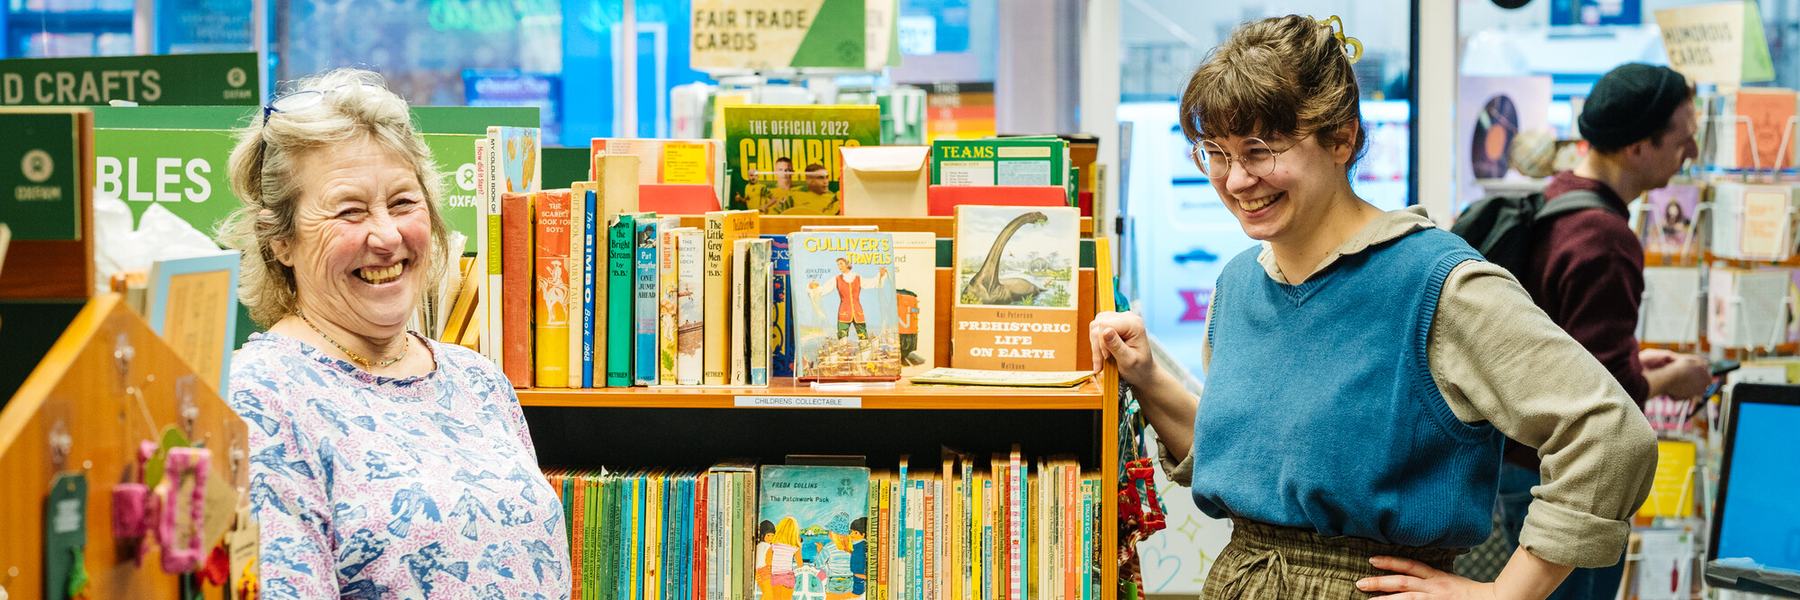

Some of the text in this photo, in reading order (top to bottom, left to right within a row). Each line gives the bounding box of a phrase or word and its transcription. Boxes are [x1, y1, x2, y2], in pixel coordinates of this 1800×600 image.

[694, 10, 809, 29] FAIR TRADE
[1665, 23, 1733, 43] HUMOROUS
[693, 33, 758, 51] CARDS
[1669, 46, 1715, 66] CARDS
[3, 70, 162, 104] D CRAFTS
[749, 120, 850, 136] THE OFFICIAL 2022
[490, 139, 496, 150] MY
[941, 146, 994, 159] TEAMS
[739, 138, 861, 182] CANARIE
[96, 155, 212, 203] BLES
[477, 178, 485, 195] Start?
[449, 195, 477, 208] OXFA
[490, 204, 497, 214] OF
[709, 220, 721, 229] The
[616, 230, 626, 238] the
[706, 230, 724, 240] Little
[572, 243, 579, 252] OF
[611, 240, 631, 251] Bright
[707, 241, 722, 251] Grey
[803, 237, 891, 252] GULLIVER'S
[609, 250, 631, 259] Stream
[641, 251, 652, 260] Pat
[708, 252, 721, 261] Men
[845, 252, 892, 265] TRAVELS
[584, 234, 593, 304] BIMBO
[1007, 311, 1034, 319] Peterson
[583, 308, 591, 337] Book
[958, 321, 1071, 333] PREHISTORIC
[994, 335, 1033, 345] LIFE
[969, 347, 1056, 359] ON EARTH
[754, 397, 843, 406] CHILDRENS COLLECTABLE
[771, 481, 792, 489] FREDA
[782, 495, 813, 503] Patchwork
